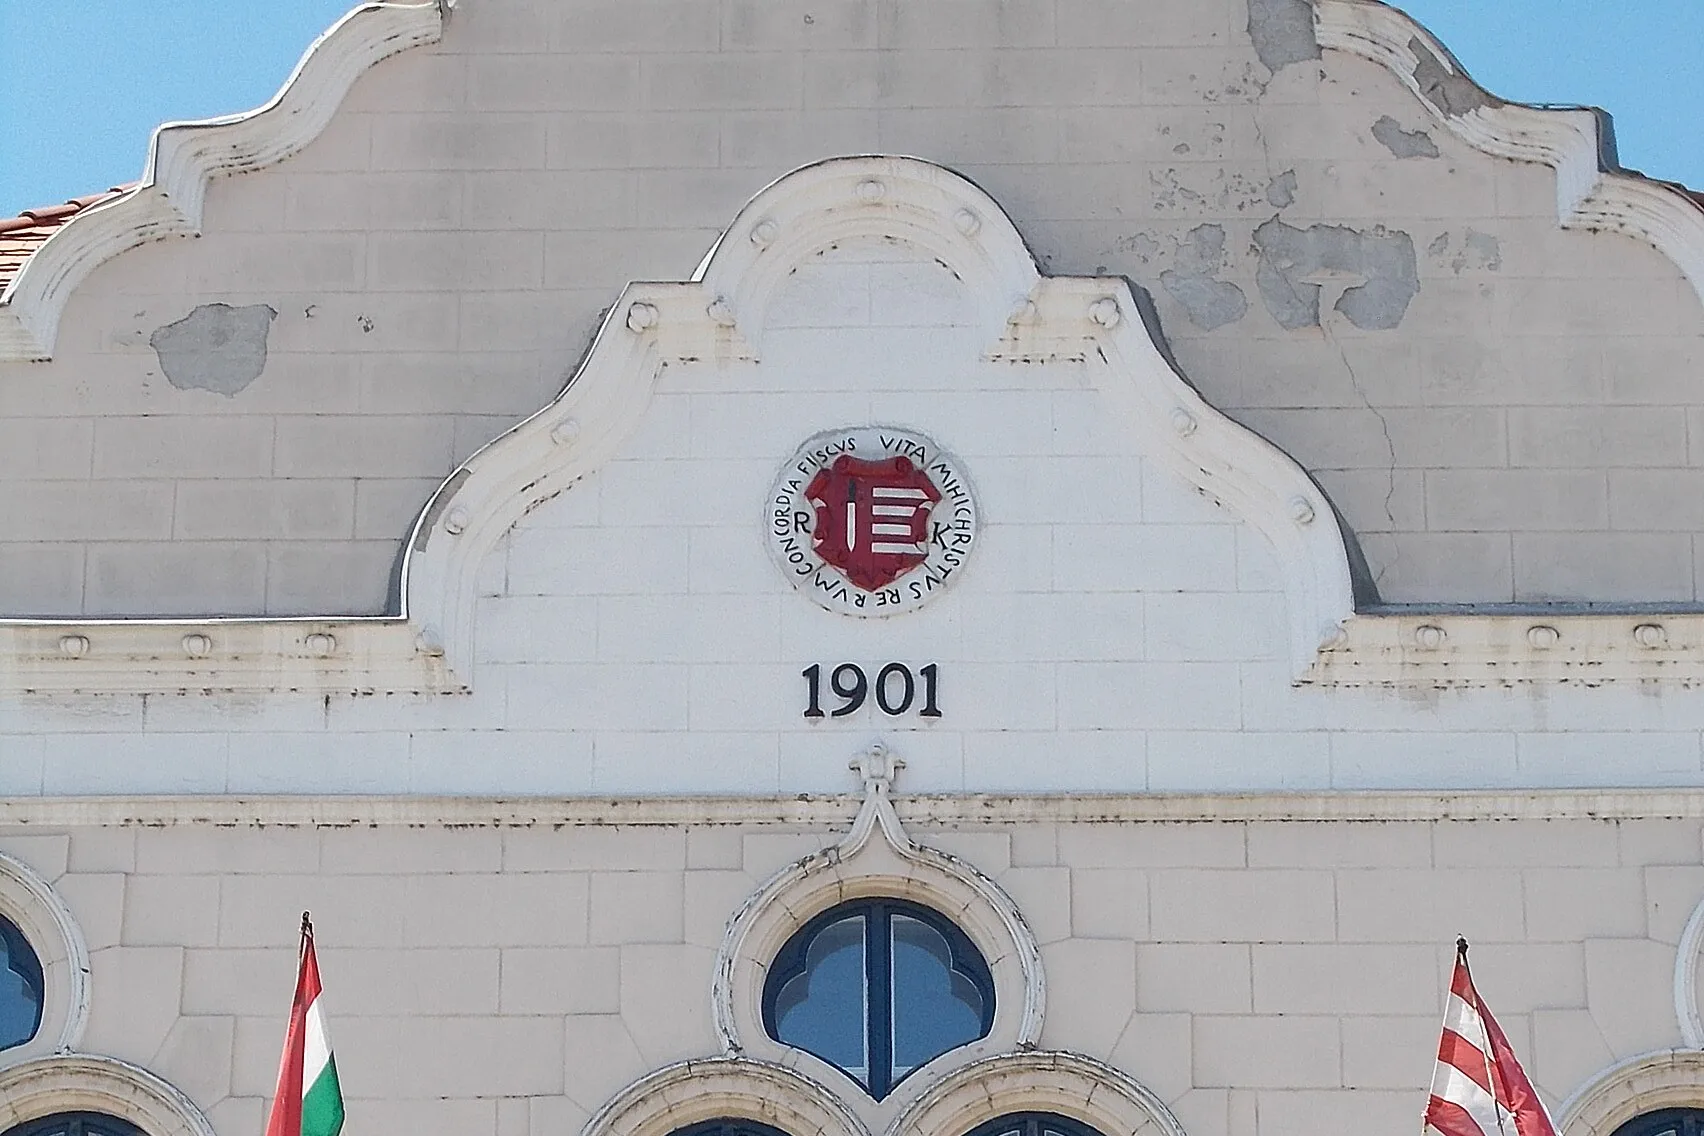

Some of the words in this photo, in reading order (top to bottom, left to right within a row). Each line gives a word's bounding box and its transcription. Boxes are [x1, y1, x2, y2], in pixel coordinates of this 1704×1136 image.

[797, 437, 856, 476] FISCVS
[880, 435, 926, 464] VITA
[773, 480, 813, 575] CONCORDIA
[793, 511, 811, 534] R
[931, 522, 953, 551] K
[802, 662, 943, 718] 1901
